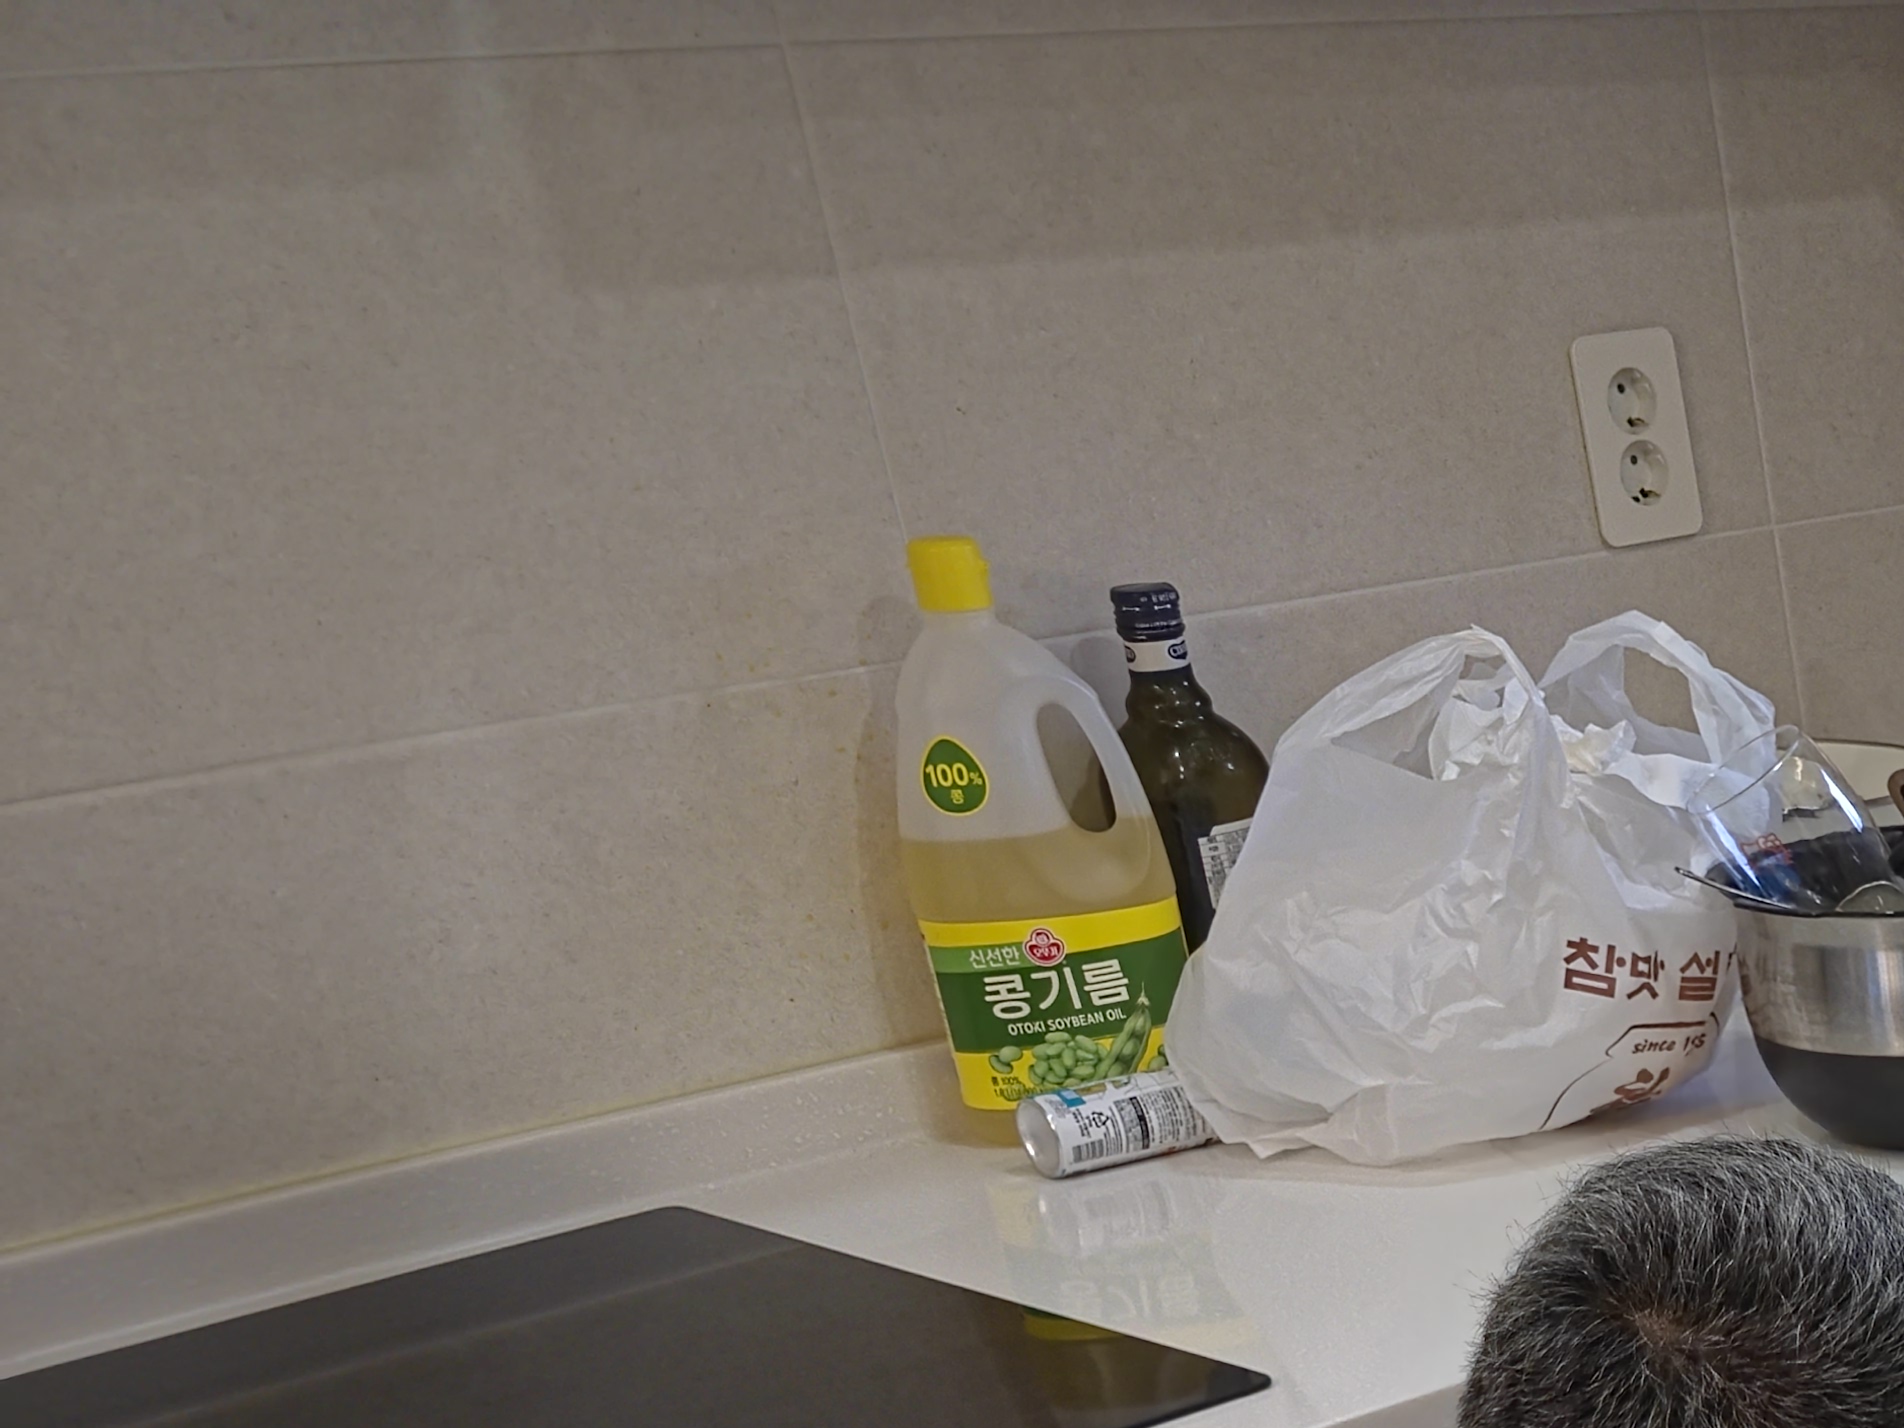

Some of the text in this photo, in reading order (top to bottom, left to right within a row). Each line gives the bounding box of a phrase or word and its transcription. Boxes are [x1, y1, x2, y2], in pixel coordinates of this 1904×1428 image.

[925, 762, 983, 788] 100%
[969, 946, 1020, 969] 신선한
[1563, 937, 1737, 1001] 참맛 설
[983, 958, 1130, 1020] 콩기름
[1007, 1007, 1127, 1036] OTOKI SOYBEAN OIL
[1632, 1038, 1677, 1054] since
